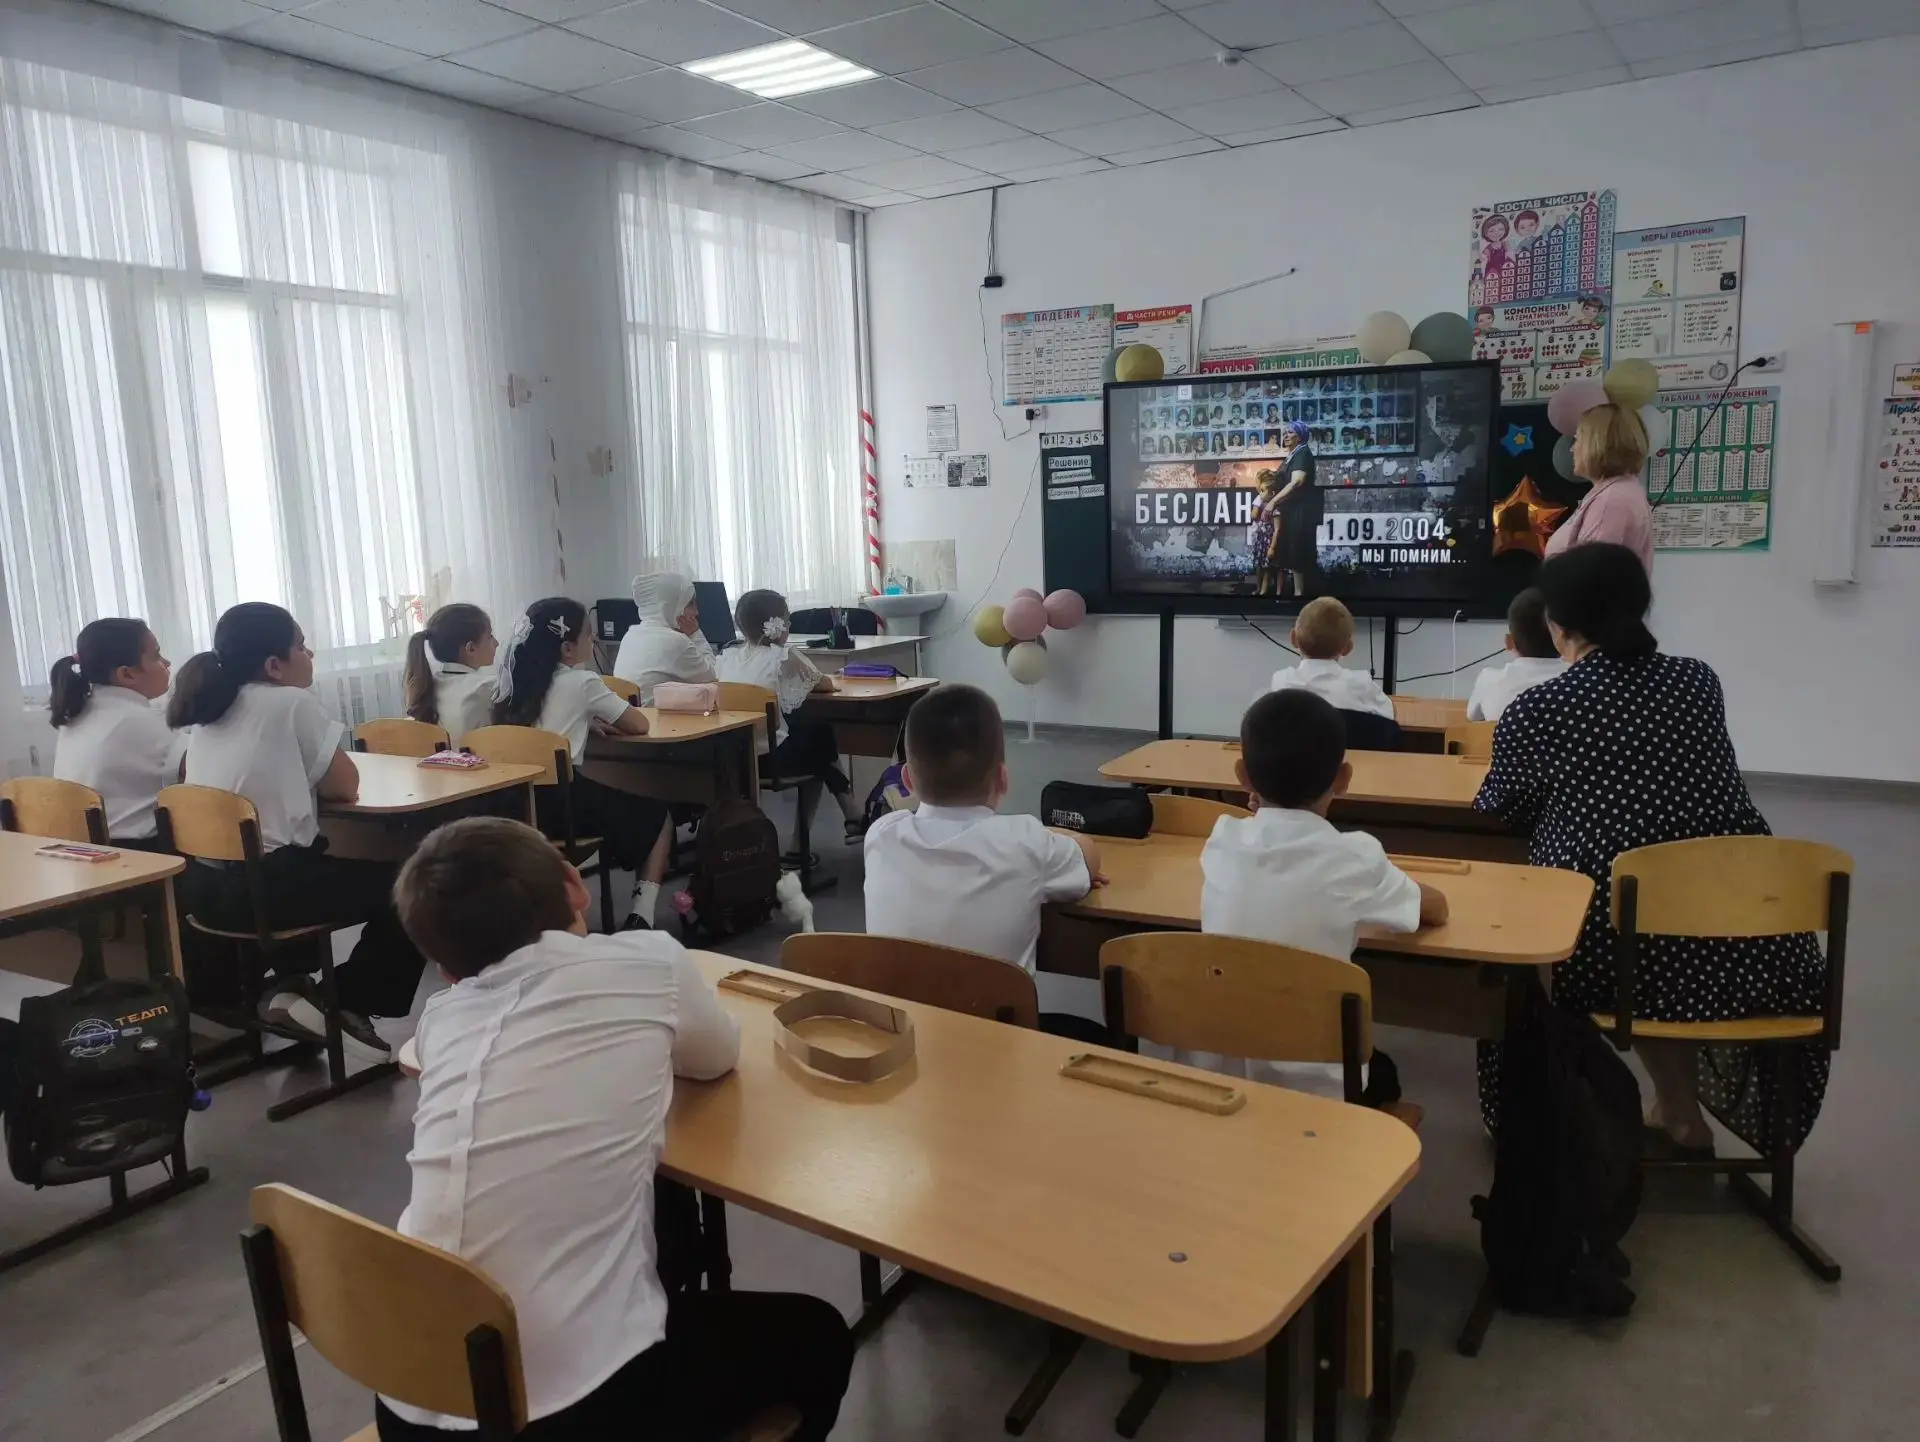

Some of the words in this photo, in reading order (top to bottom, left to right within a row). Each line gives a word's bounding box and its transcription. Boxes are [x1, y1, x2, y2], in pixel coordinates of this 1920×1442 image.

[1497, 200, 1540, 212] СОСТАВ
[1546, 194, 1585, 206] ЧИСЛА
[1641, 232, 1668, 242] МЕРЫ
[1034, 310, 1081, 322] ПАДЕЖИ
[1134, 311, 1156, 319] ЧАСТИ
[1158, 309, 1176, 317] РЕЧИ
[1504, 304, 1570, 316] КОМПОНЕНТЫ
[1505, 311, 1568, 321] МАТЕМАТИЧЕСКИХ
[1660, 394, 1700, 403] ТАБЛИЦА
[1049, 458, 1089, 467] Решение
[1135, 491, 1252, 524] БЕСЛАН
[1327, 517, 1445, 541] 1.09.2004
[1362, 548, 1384, 563] МЫ
[114, 1005, 169, 1026] TEAM
